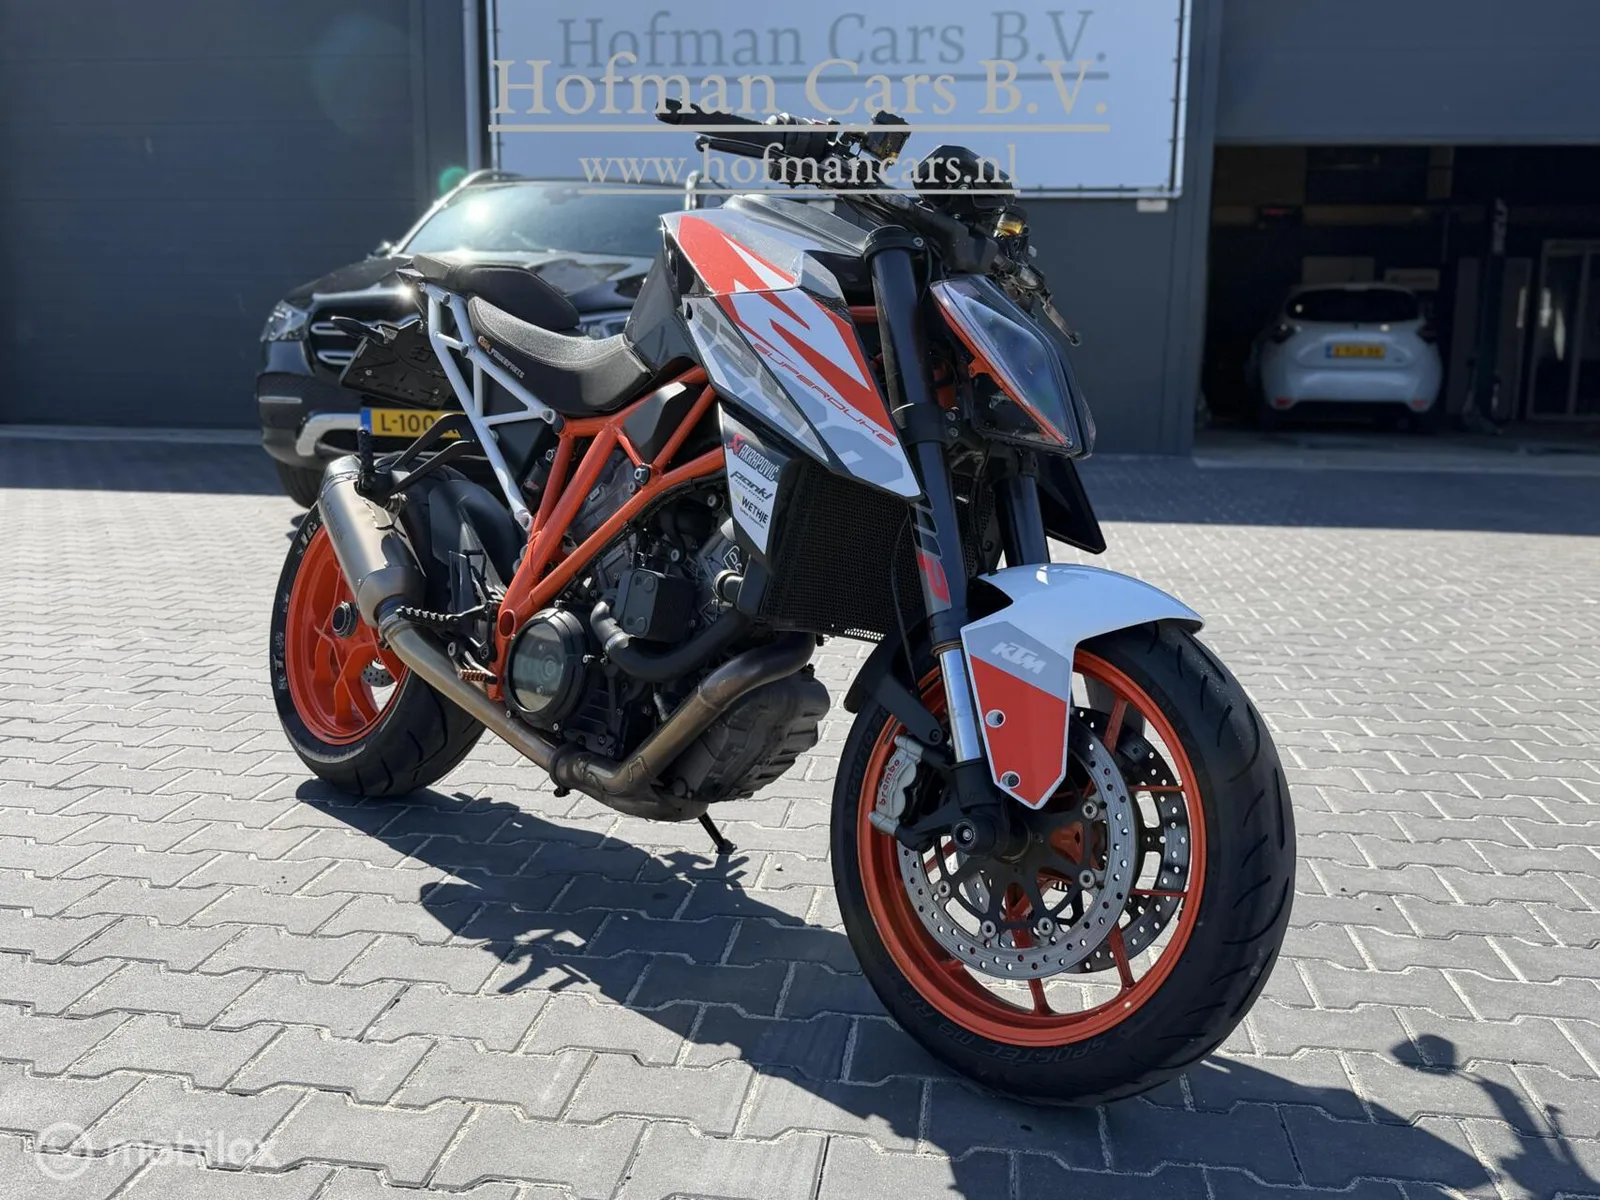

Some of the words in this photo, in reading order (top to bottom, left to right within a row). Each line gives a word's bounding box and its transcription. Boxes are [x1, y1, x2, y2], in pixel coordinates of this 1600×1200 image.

[558, 10, 806, 69] Hofman
[828, 13, 965, 64] Cars
[990, 10, 1106, 63] B.V.
[990, 641, 1047, 675] KTM
[880, 757, 901, 806] brembo
